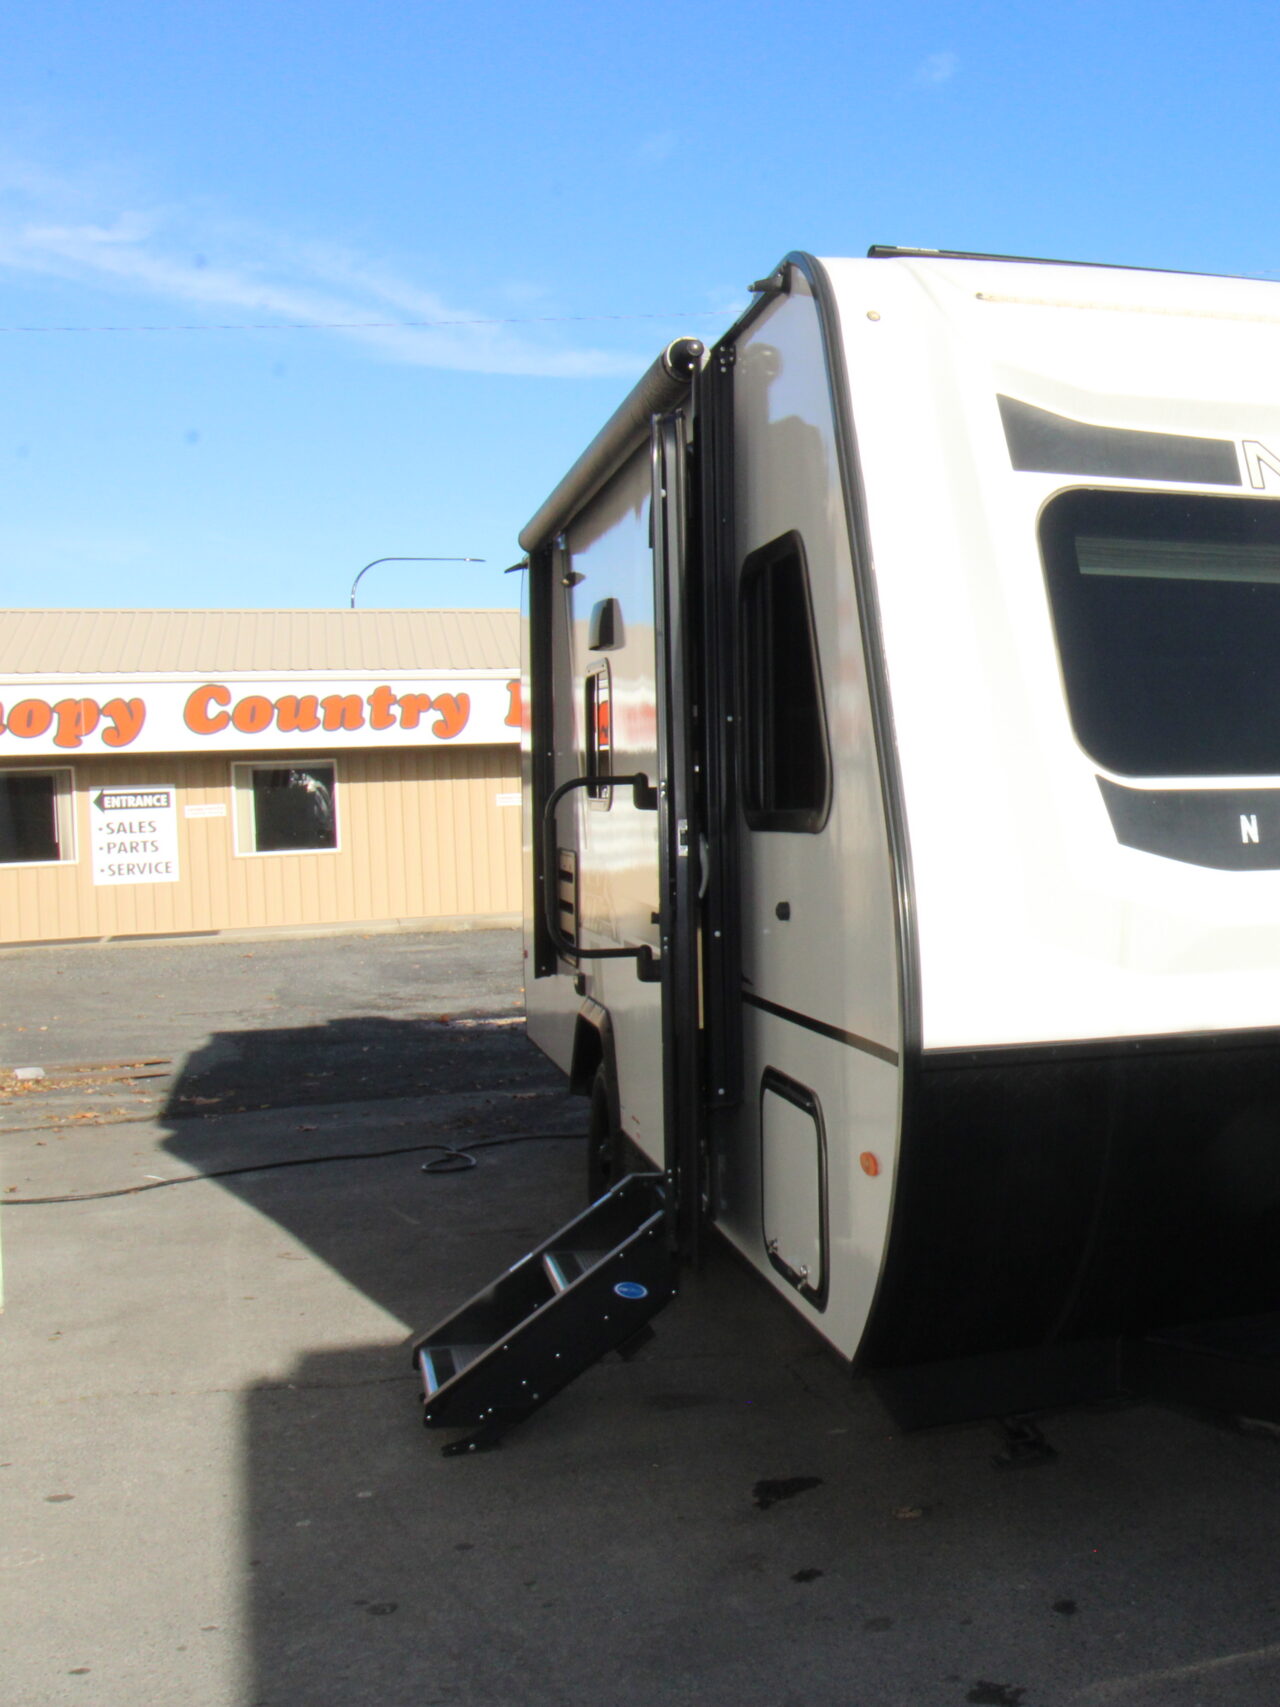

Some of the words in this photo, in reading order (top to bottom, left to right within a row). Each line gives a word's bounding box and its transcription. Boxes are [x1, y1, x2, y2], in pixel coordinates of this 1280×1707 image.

[0, 697, 146, 749] opy
[183, 683, 471, 740] Country
[103, 793, 169, 810] ENTRANCE
[106, 820, 157, 835] SALES
[106, 840, 159, 855] PARTS
[107, 861, 173, 877] SERVICE
